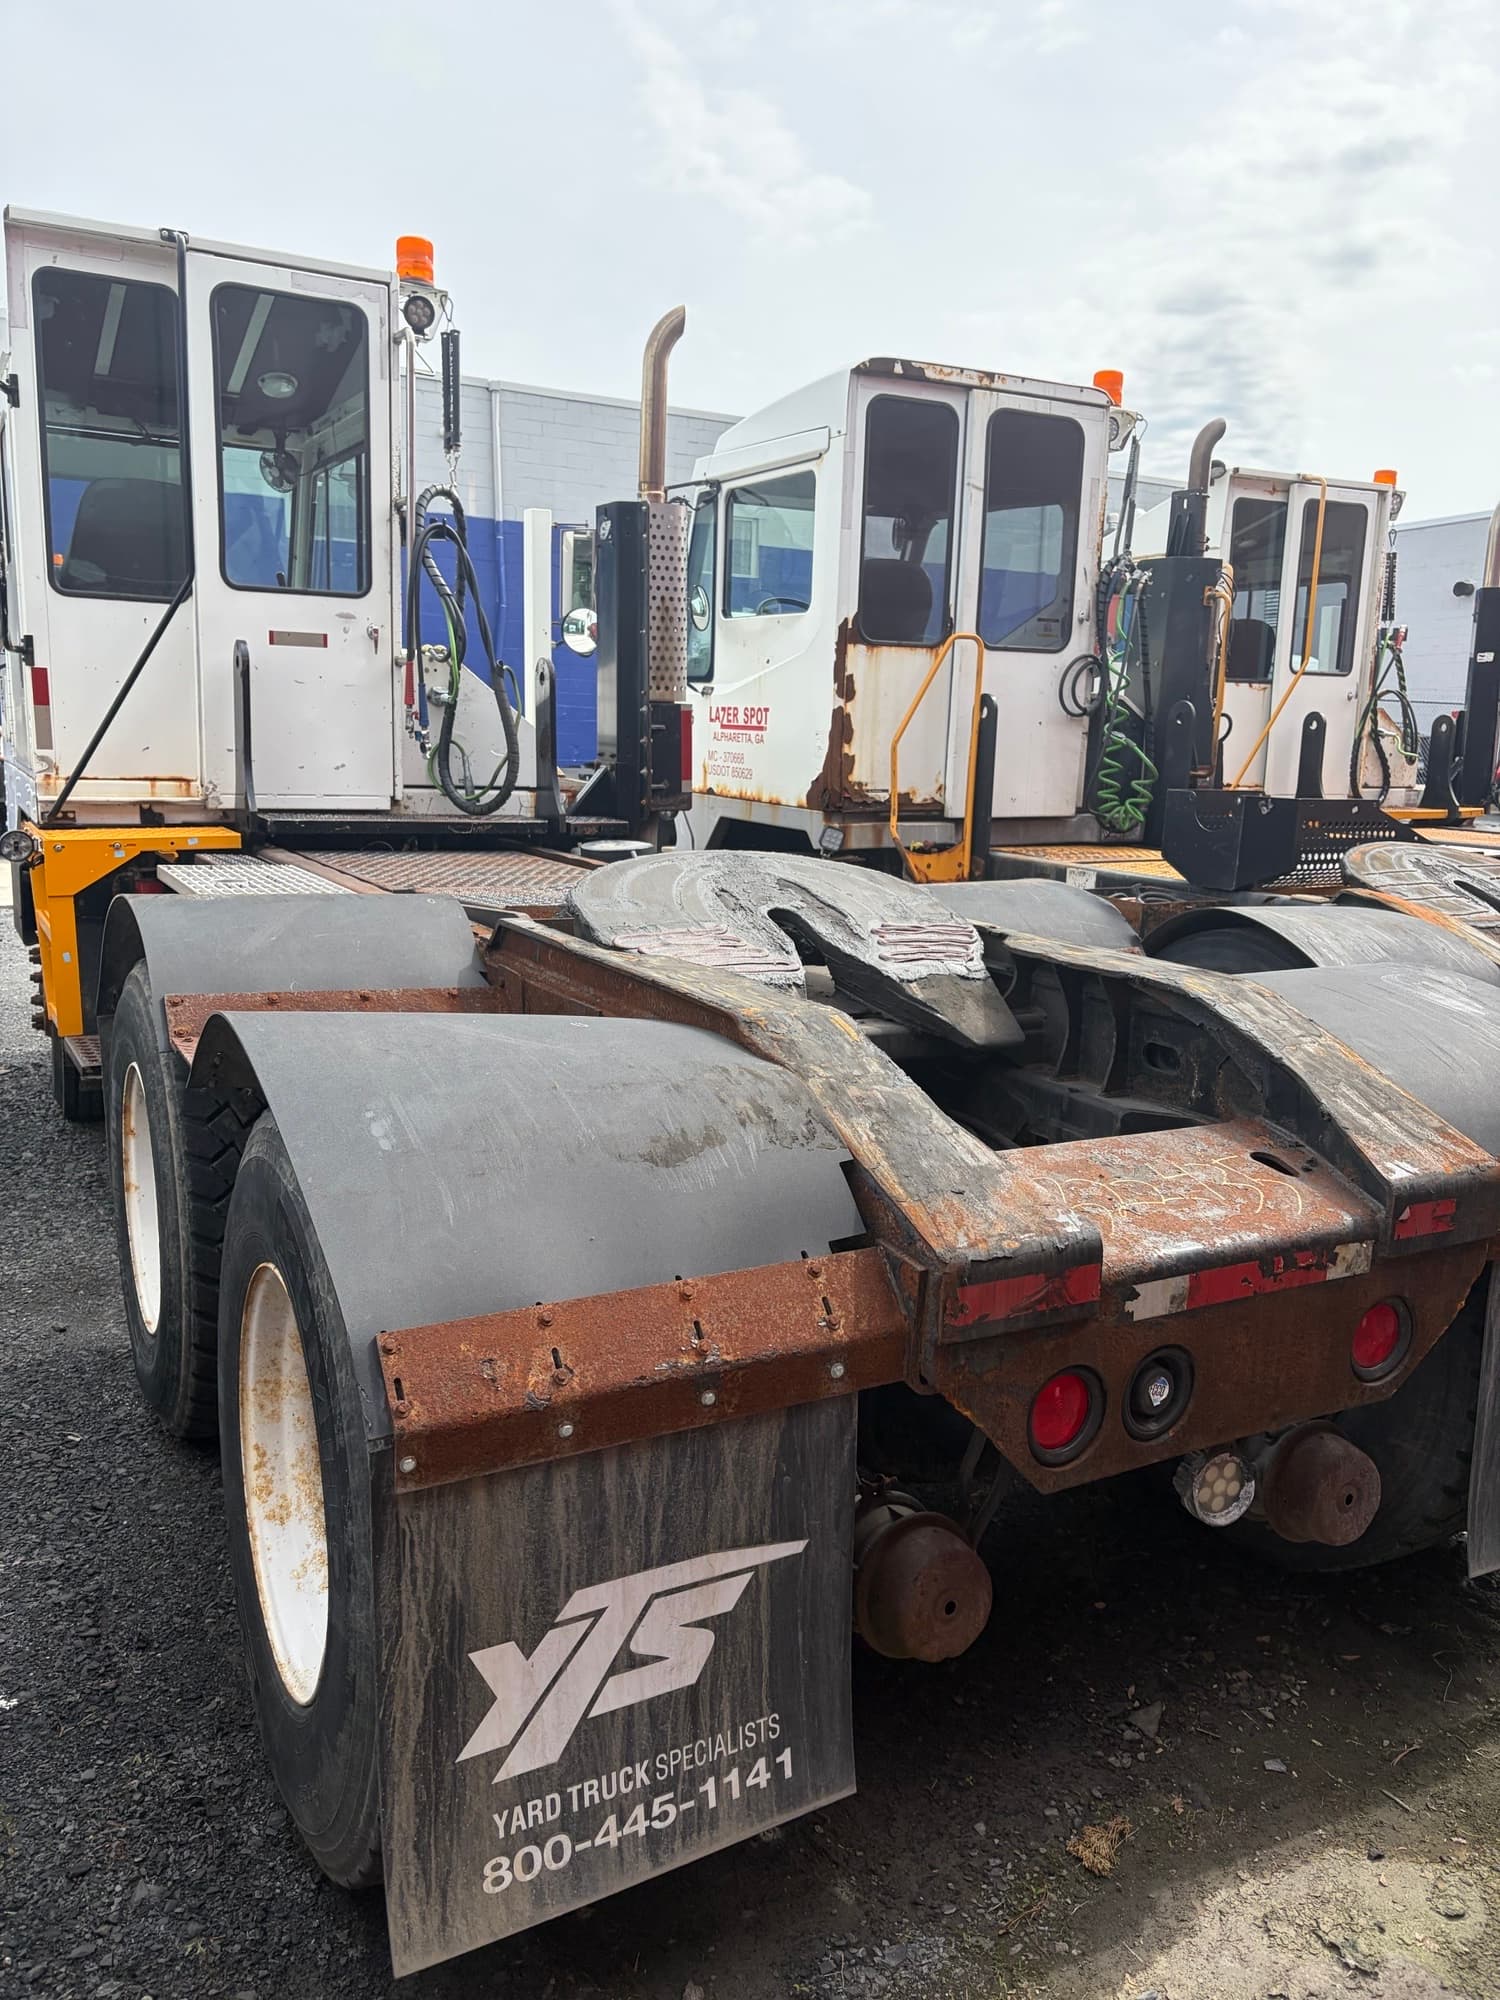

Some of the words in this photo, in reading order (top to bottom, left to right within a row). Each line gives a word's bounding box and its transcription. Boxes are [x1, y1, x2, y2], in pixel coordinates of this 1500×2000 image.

[709, 706, 739, 725] LAZER
[743, 707, 769, 726] SPOT
[755, 733, 765, 744] GA
[708, 750, 718, 761] MC
[708, 764, 730, 776] USDOT
[455, 1539, 809, 1784] YTS
[493, 1792, 560, 1839] YARD
[567, 1760, 650, 1808] TRUCK
[656, 1713, 780, 1780] SPECIALISTS
[482, 1747, 793, 1894] 800-445-1141
